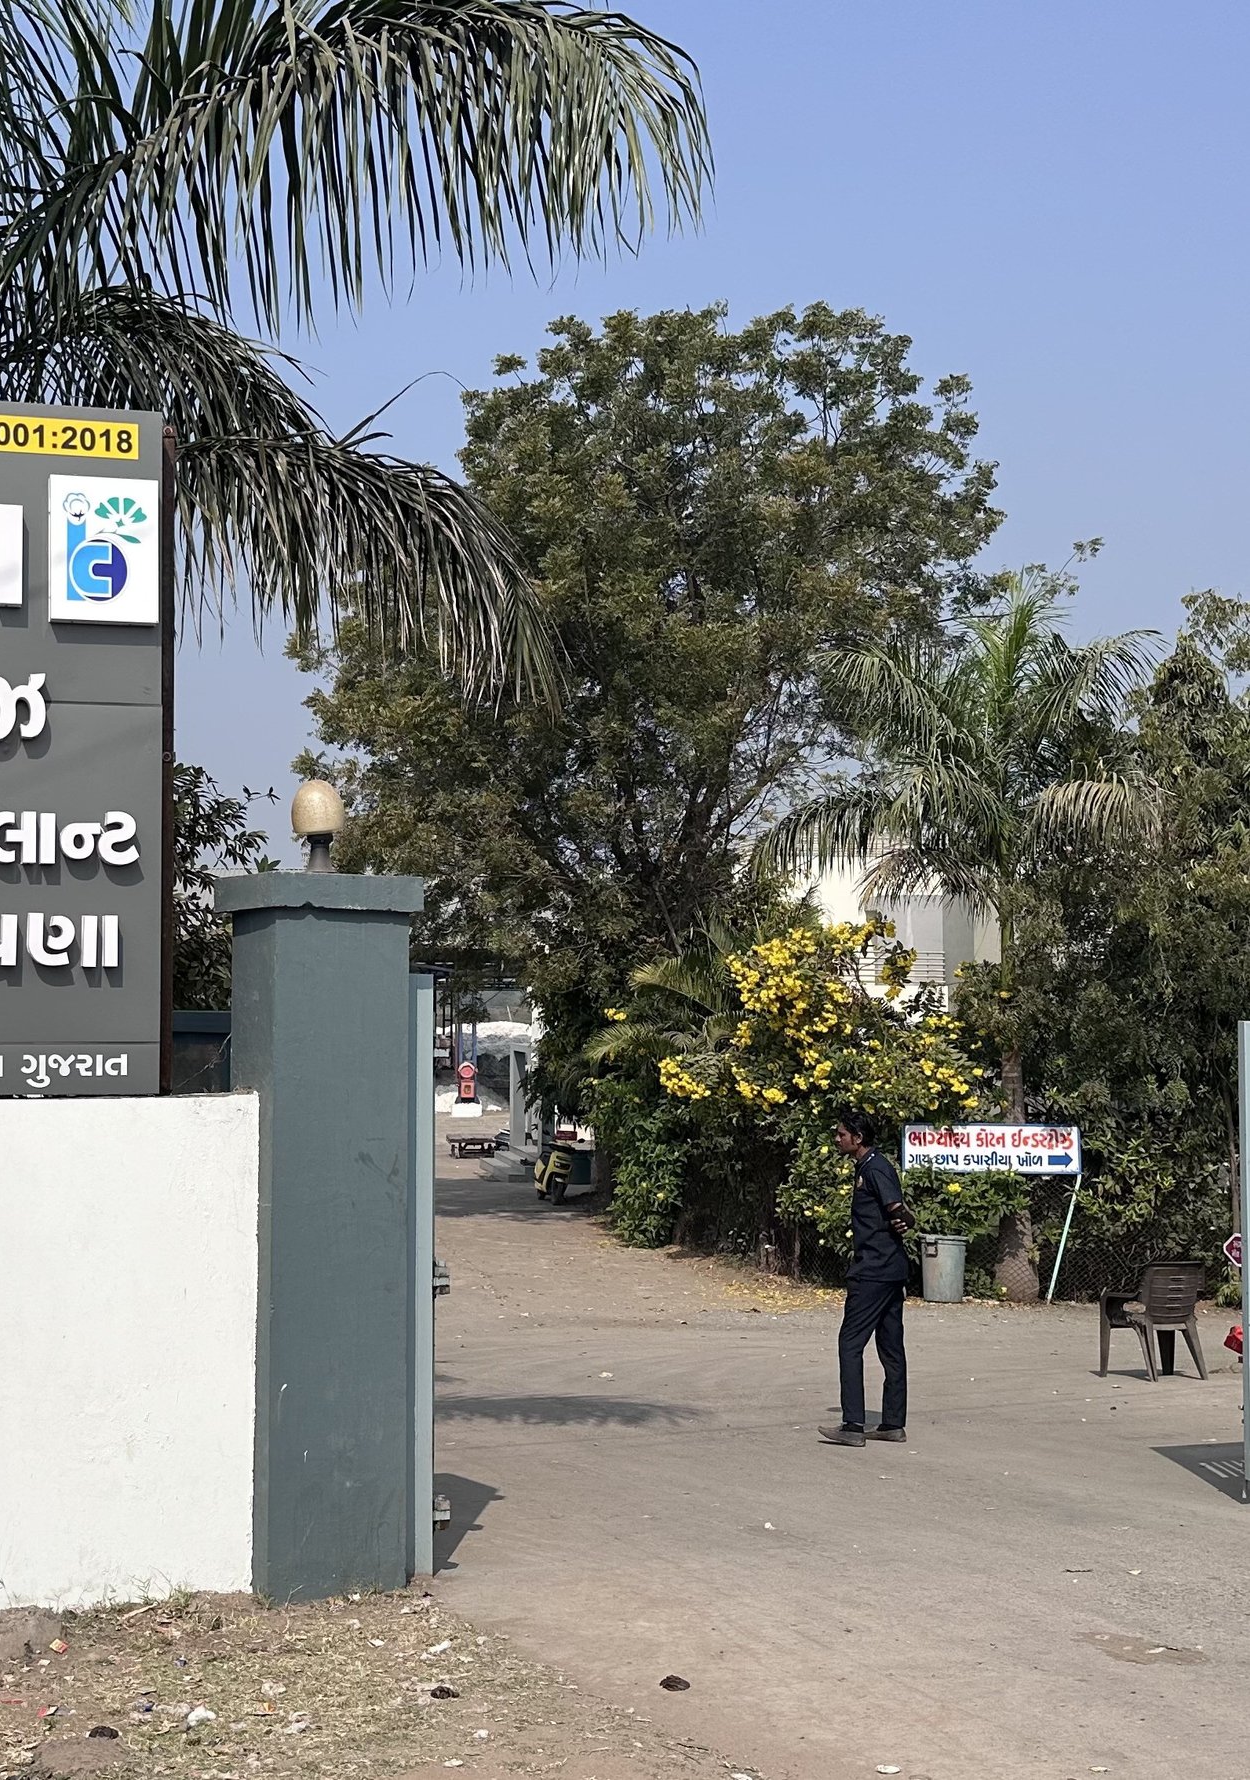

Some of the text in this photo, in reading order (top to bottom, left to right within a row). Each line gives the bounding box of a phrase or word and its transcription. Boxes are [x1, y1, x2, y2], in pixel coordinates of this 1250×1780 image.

[20, 1052, 129, 1088] ગુજરાત
[976, 1128, 1006, 1148] કોટન
[908, 1151, 1043, 1167] ગાય છાપ કપાસીયા ખોળ
